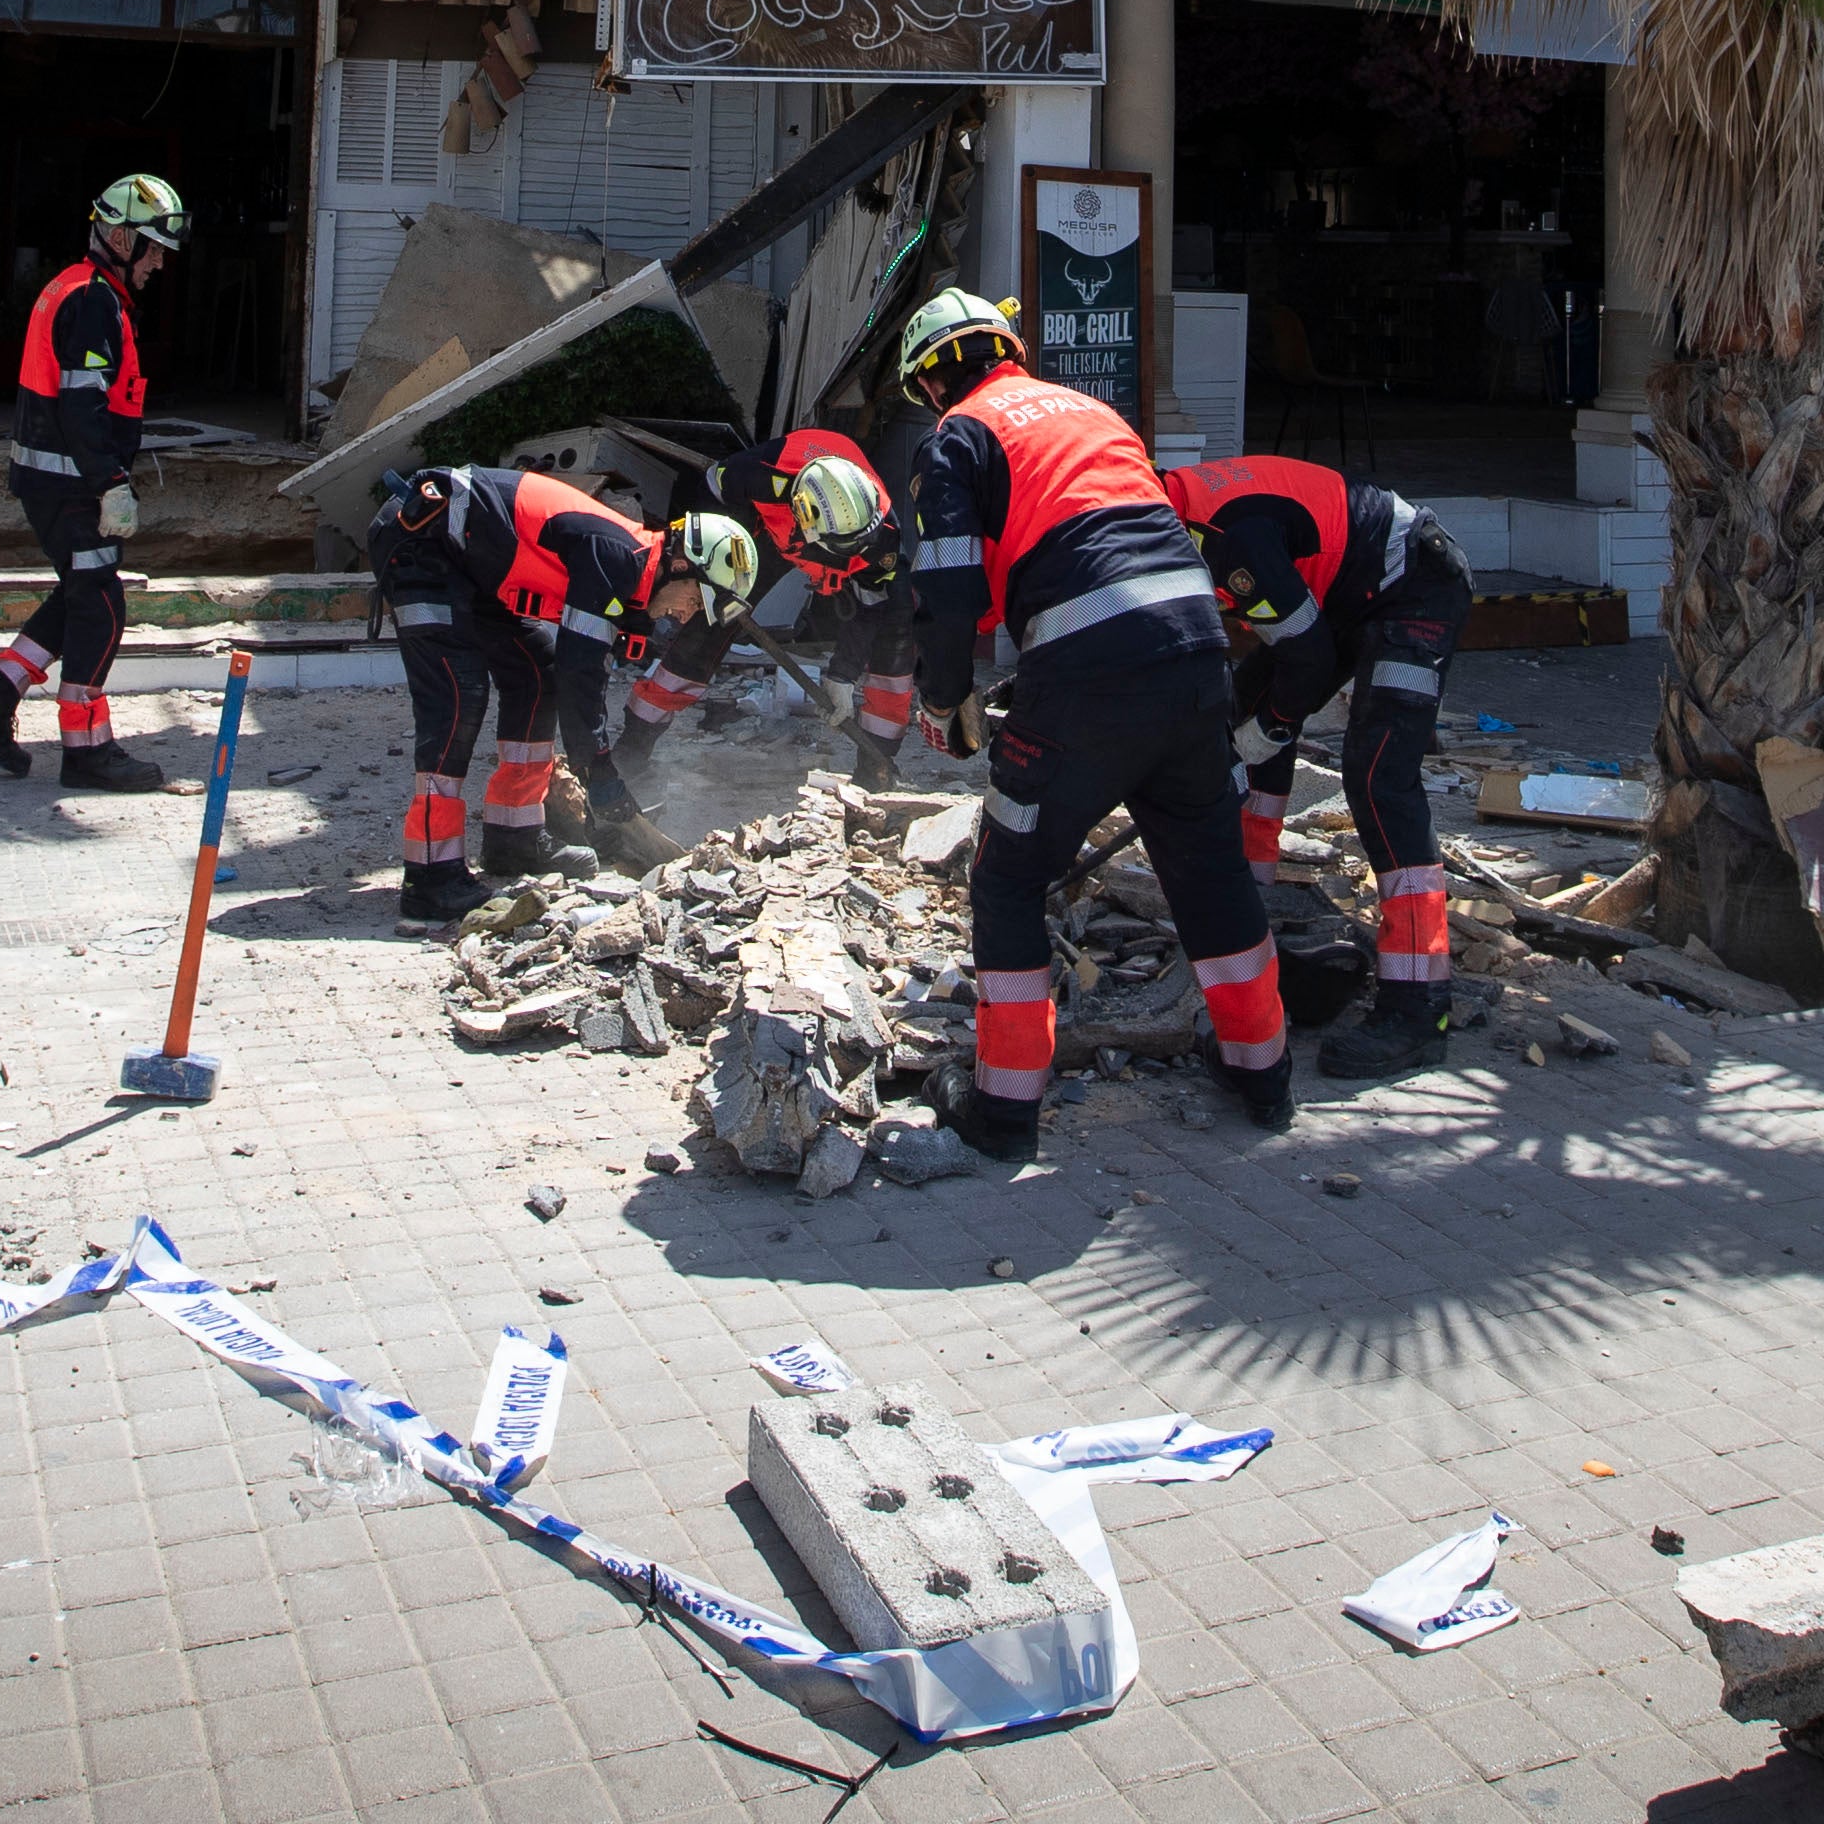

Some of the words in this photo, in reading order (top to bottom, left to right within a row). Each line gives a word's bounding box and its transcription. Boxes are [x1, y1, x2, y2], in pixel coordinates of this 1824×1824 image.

[1058, 220, 1117, 232] MEDUSA
[1043, 314, 1078, 346] BBQ
[1086, 311, 1133, 345] GRILL
[1059, 351, 1118, 376] FILETSTEAK
[1005, 403, 1045, 427] DE
[500, 1364, 554, 1412] POLICIA
